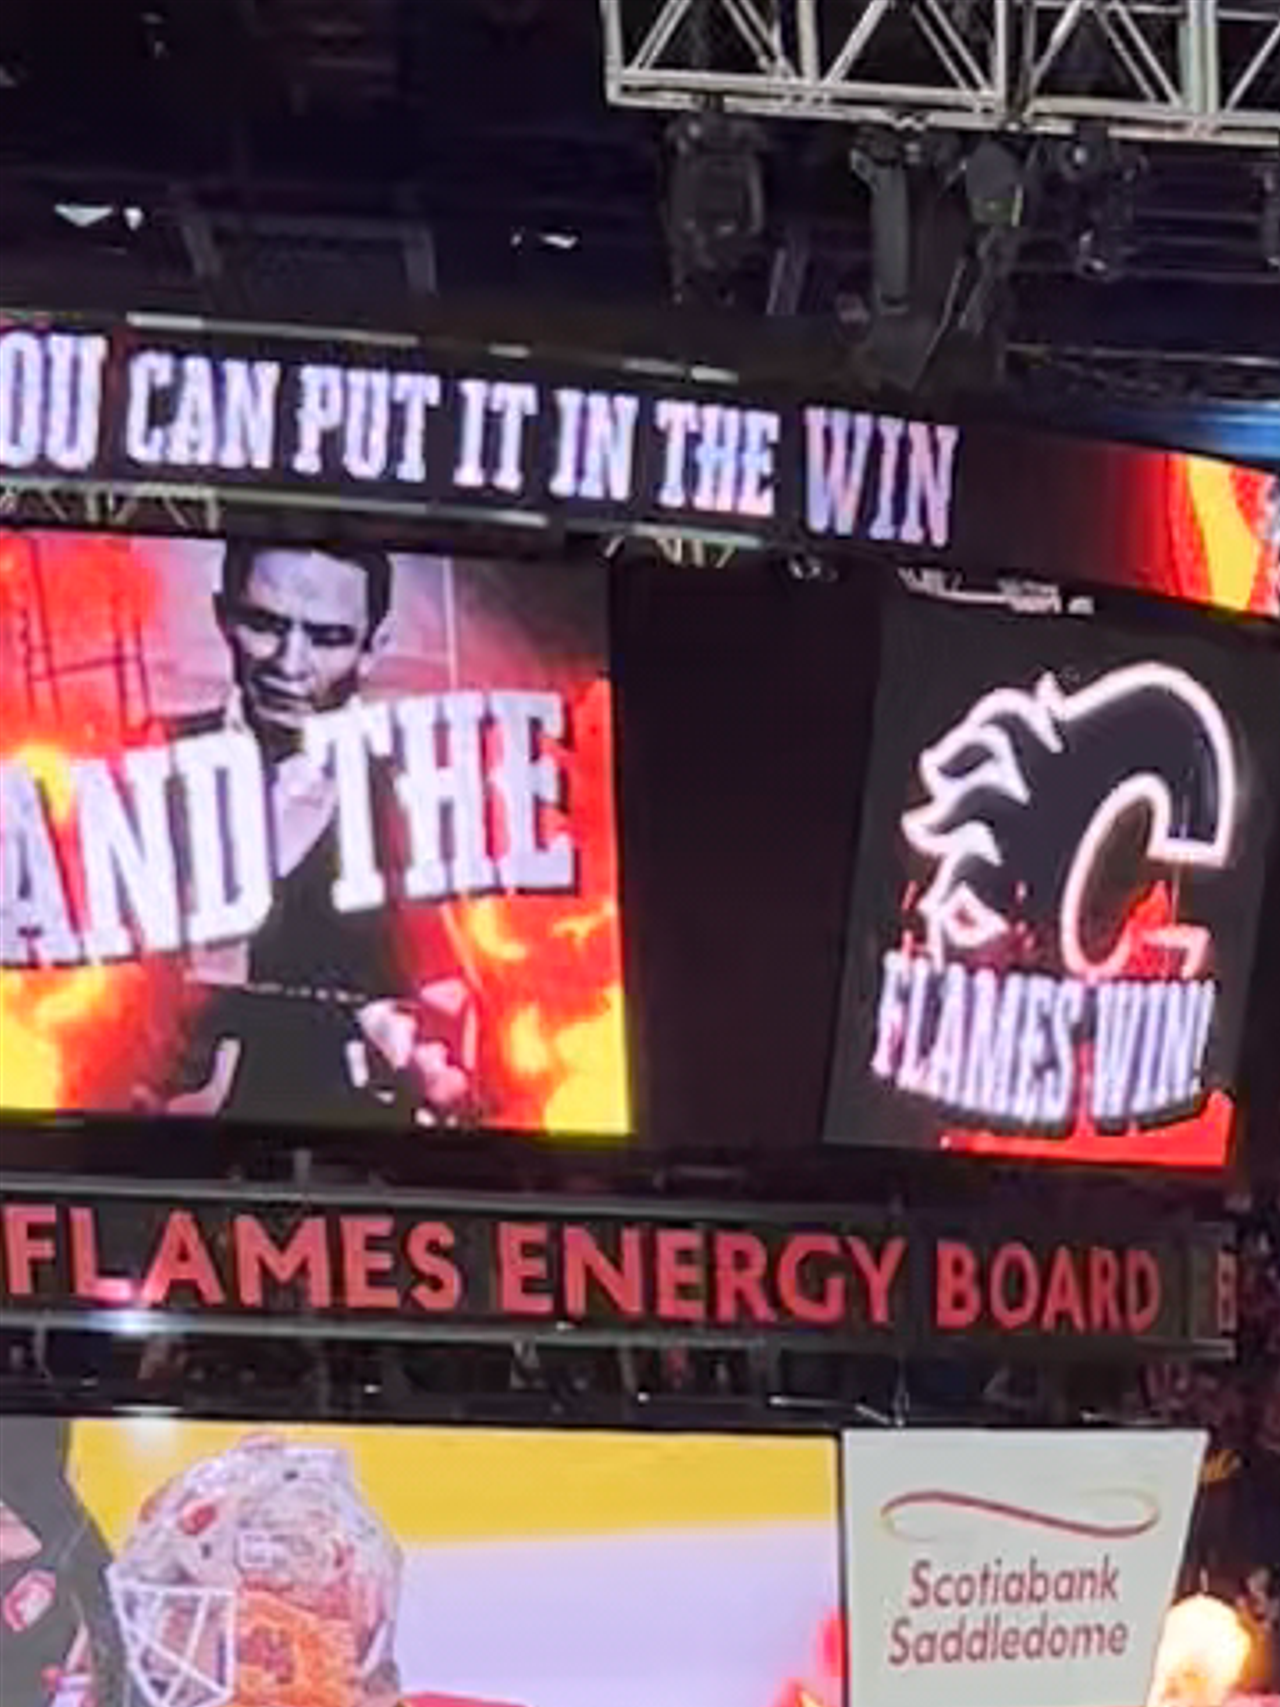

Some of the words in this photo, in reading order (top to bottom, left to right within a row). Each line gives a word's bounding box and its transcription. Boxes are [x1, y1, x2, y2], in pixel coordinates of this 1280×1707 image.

[125, 350, 280, 469] CAN
[294, 364, 440, 482] PUT
[453, 379, 538, 491] IT
[549, 388, 639, 501] IN
[655, 400, 780, 516] THE
[804, 406, 960, 548] WIN
[0, 730, 273, 960] AND
[303, 690, 575, 912] THE
[872, 950, 1085, 1126] FLAMES
[1090, 978, 1216, 1120] WIN!
[3, 1204, 462, 1310] FLAMES
[498, 1220, 906, 1323] ENERGY
[936, 1238, 1162, 1330] BOARD
[888, 1613, 1130, 1665] Saddledome
[909, 1553, 1120, 1609] Scotiabank
